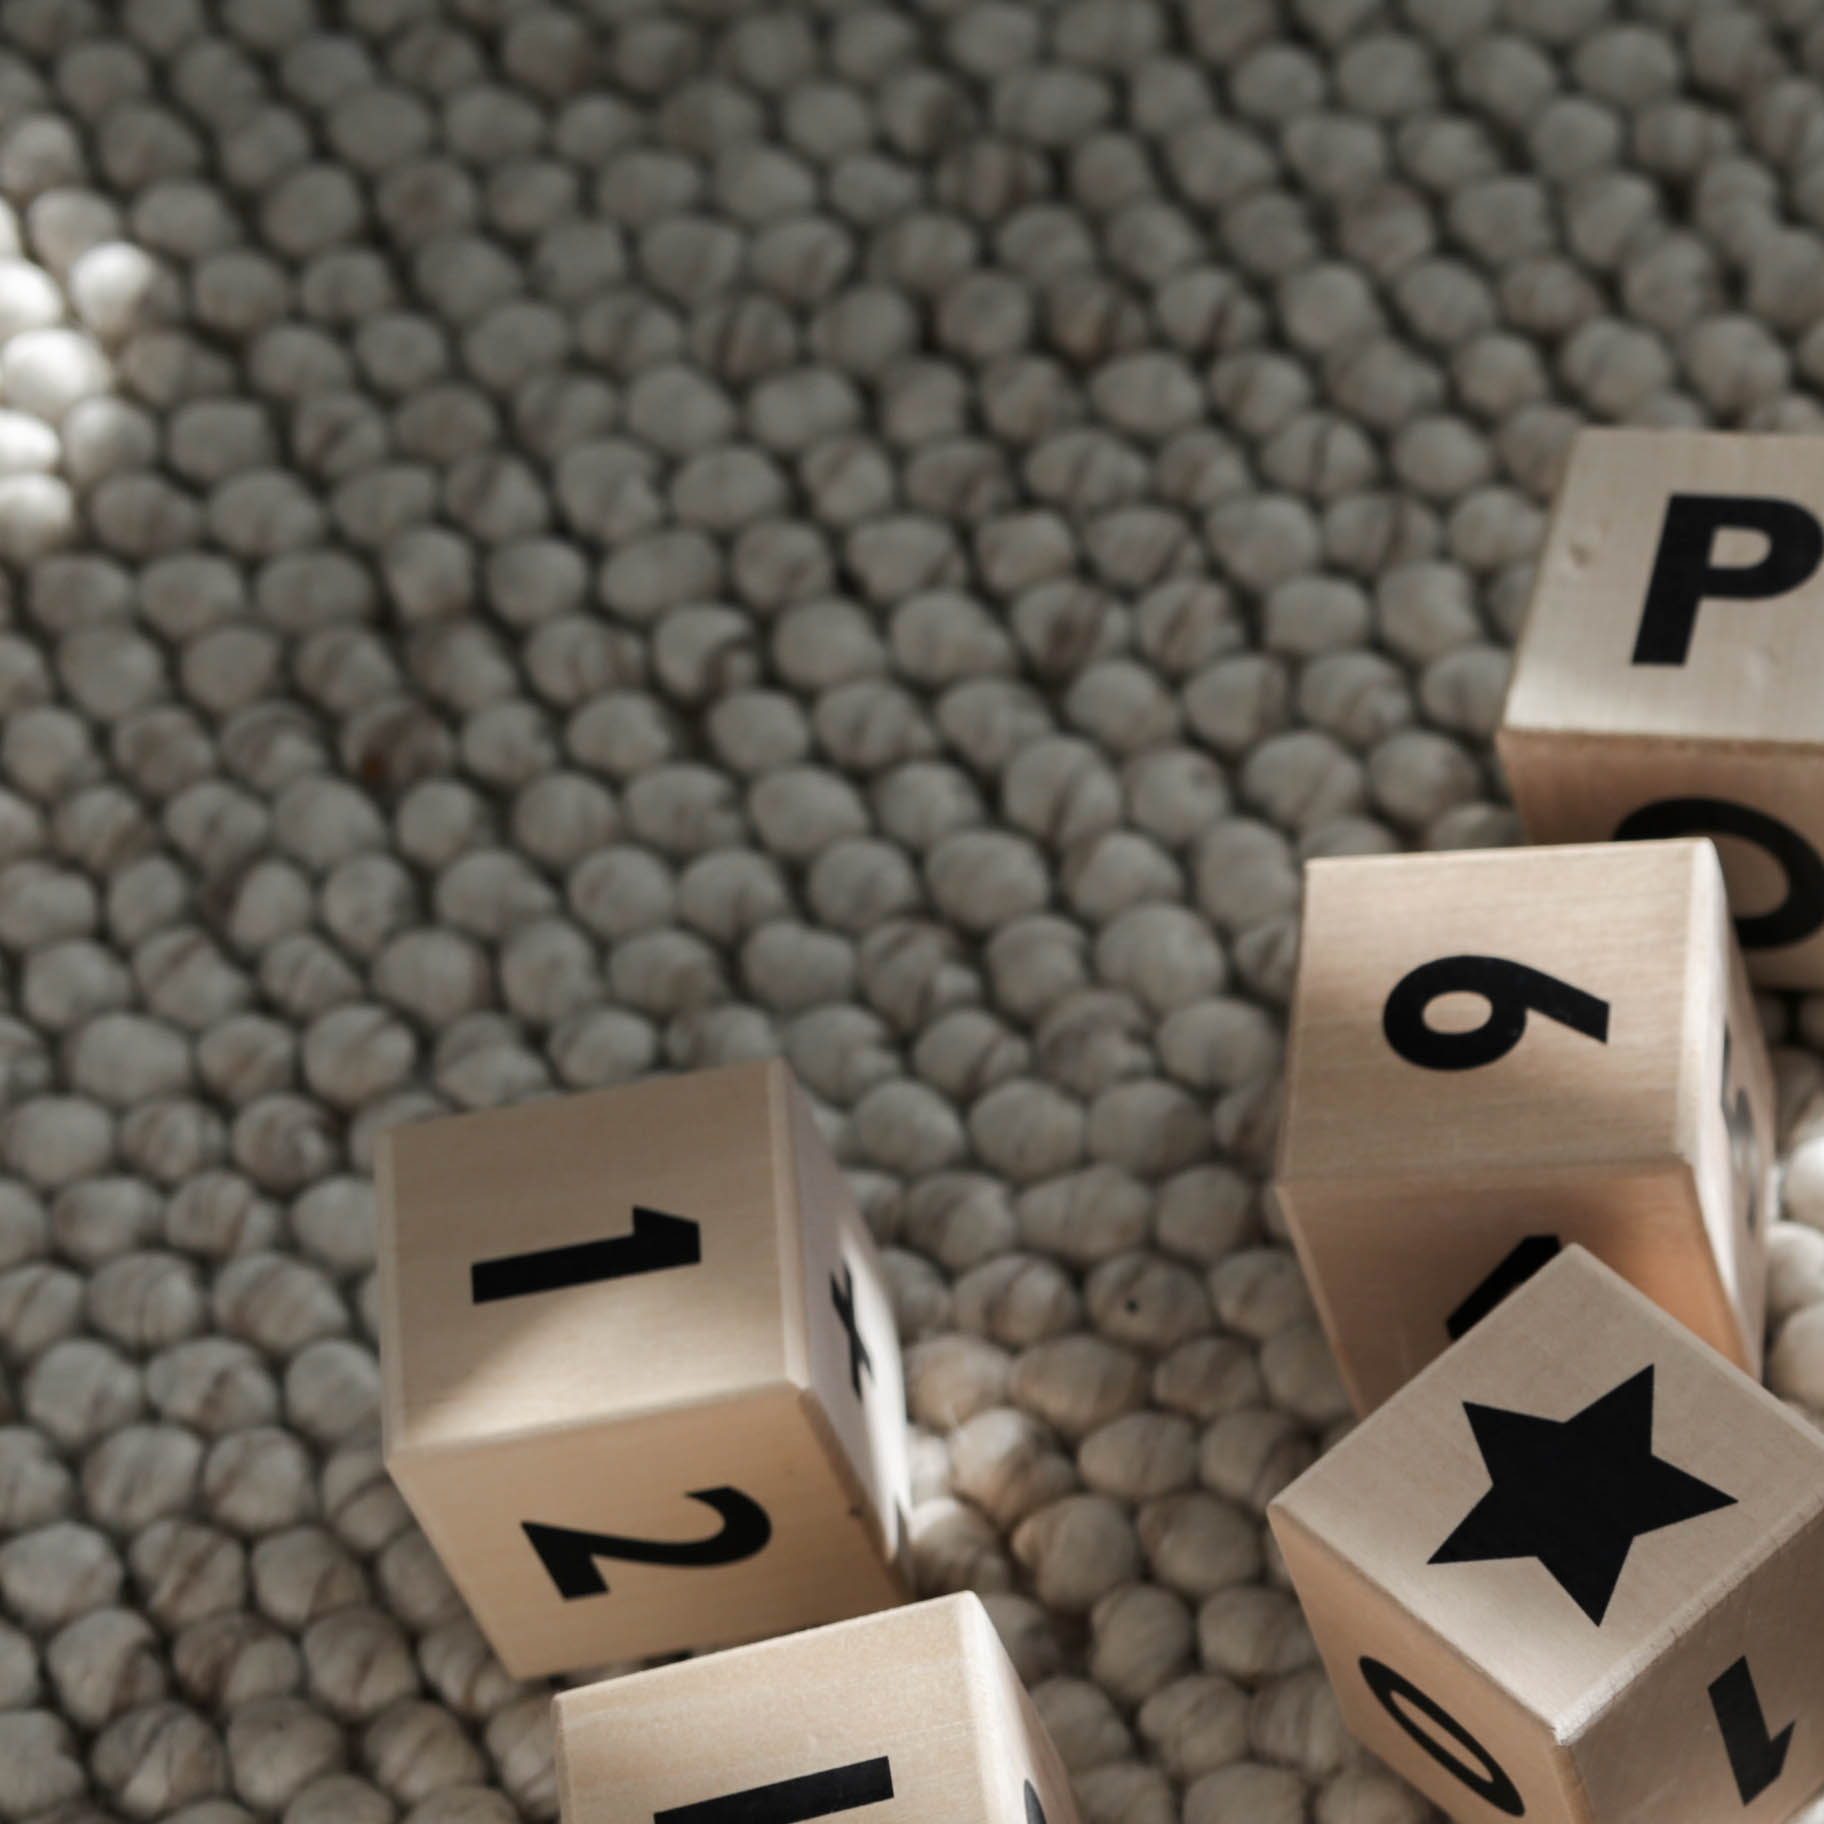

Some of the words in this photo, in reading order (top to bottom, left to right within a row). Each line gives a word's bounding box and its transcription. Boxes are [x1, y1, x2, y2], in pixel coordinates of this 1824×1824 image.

[1633, 495, 1824, 666] P
[471, 1206, 701, 1304] 1
[521, 1486, 772, 1601] 2
[1708, 1655, 1796, 1805] 1
